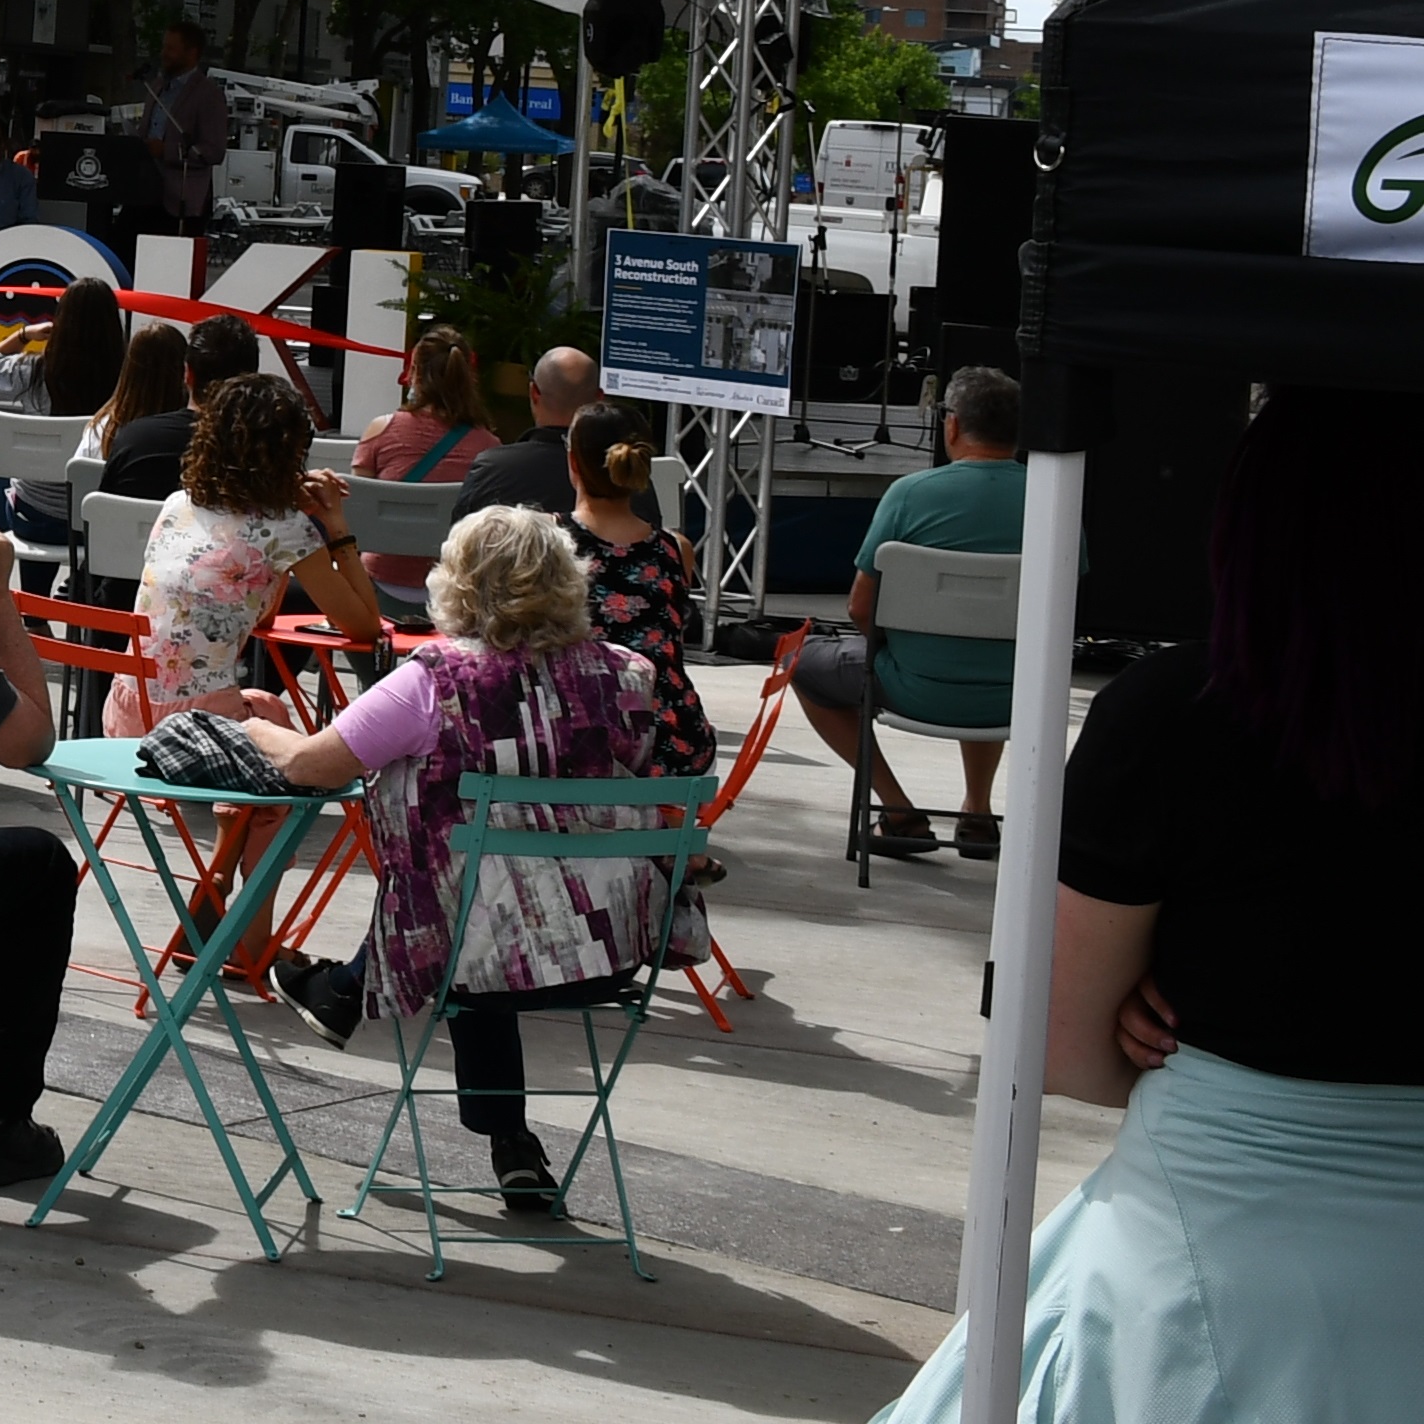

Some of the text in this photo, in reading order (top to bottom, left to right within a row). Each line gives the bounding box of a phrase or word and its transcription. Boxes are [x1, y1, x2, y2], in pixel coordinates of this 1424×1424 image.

[614, 254, 700, 273] 3 Avenue South
[614, 267, 698, 286] Reconstruction
